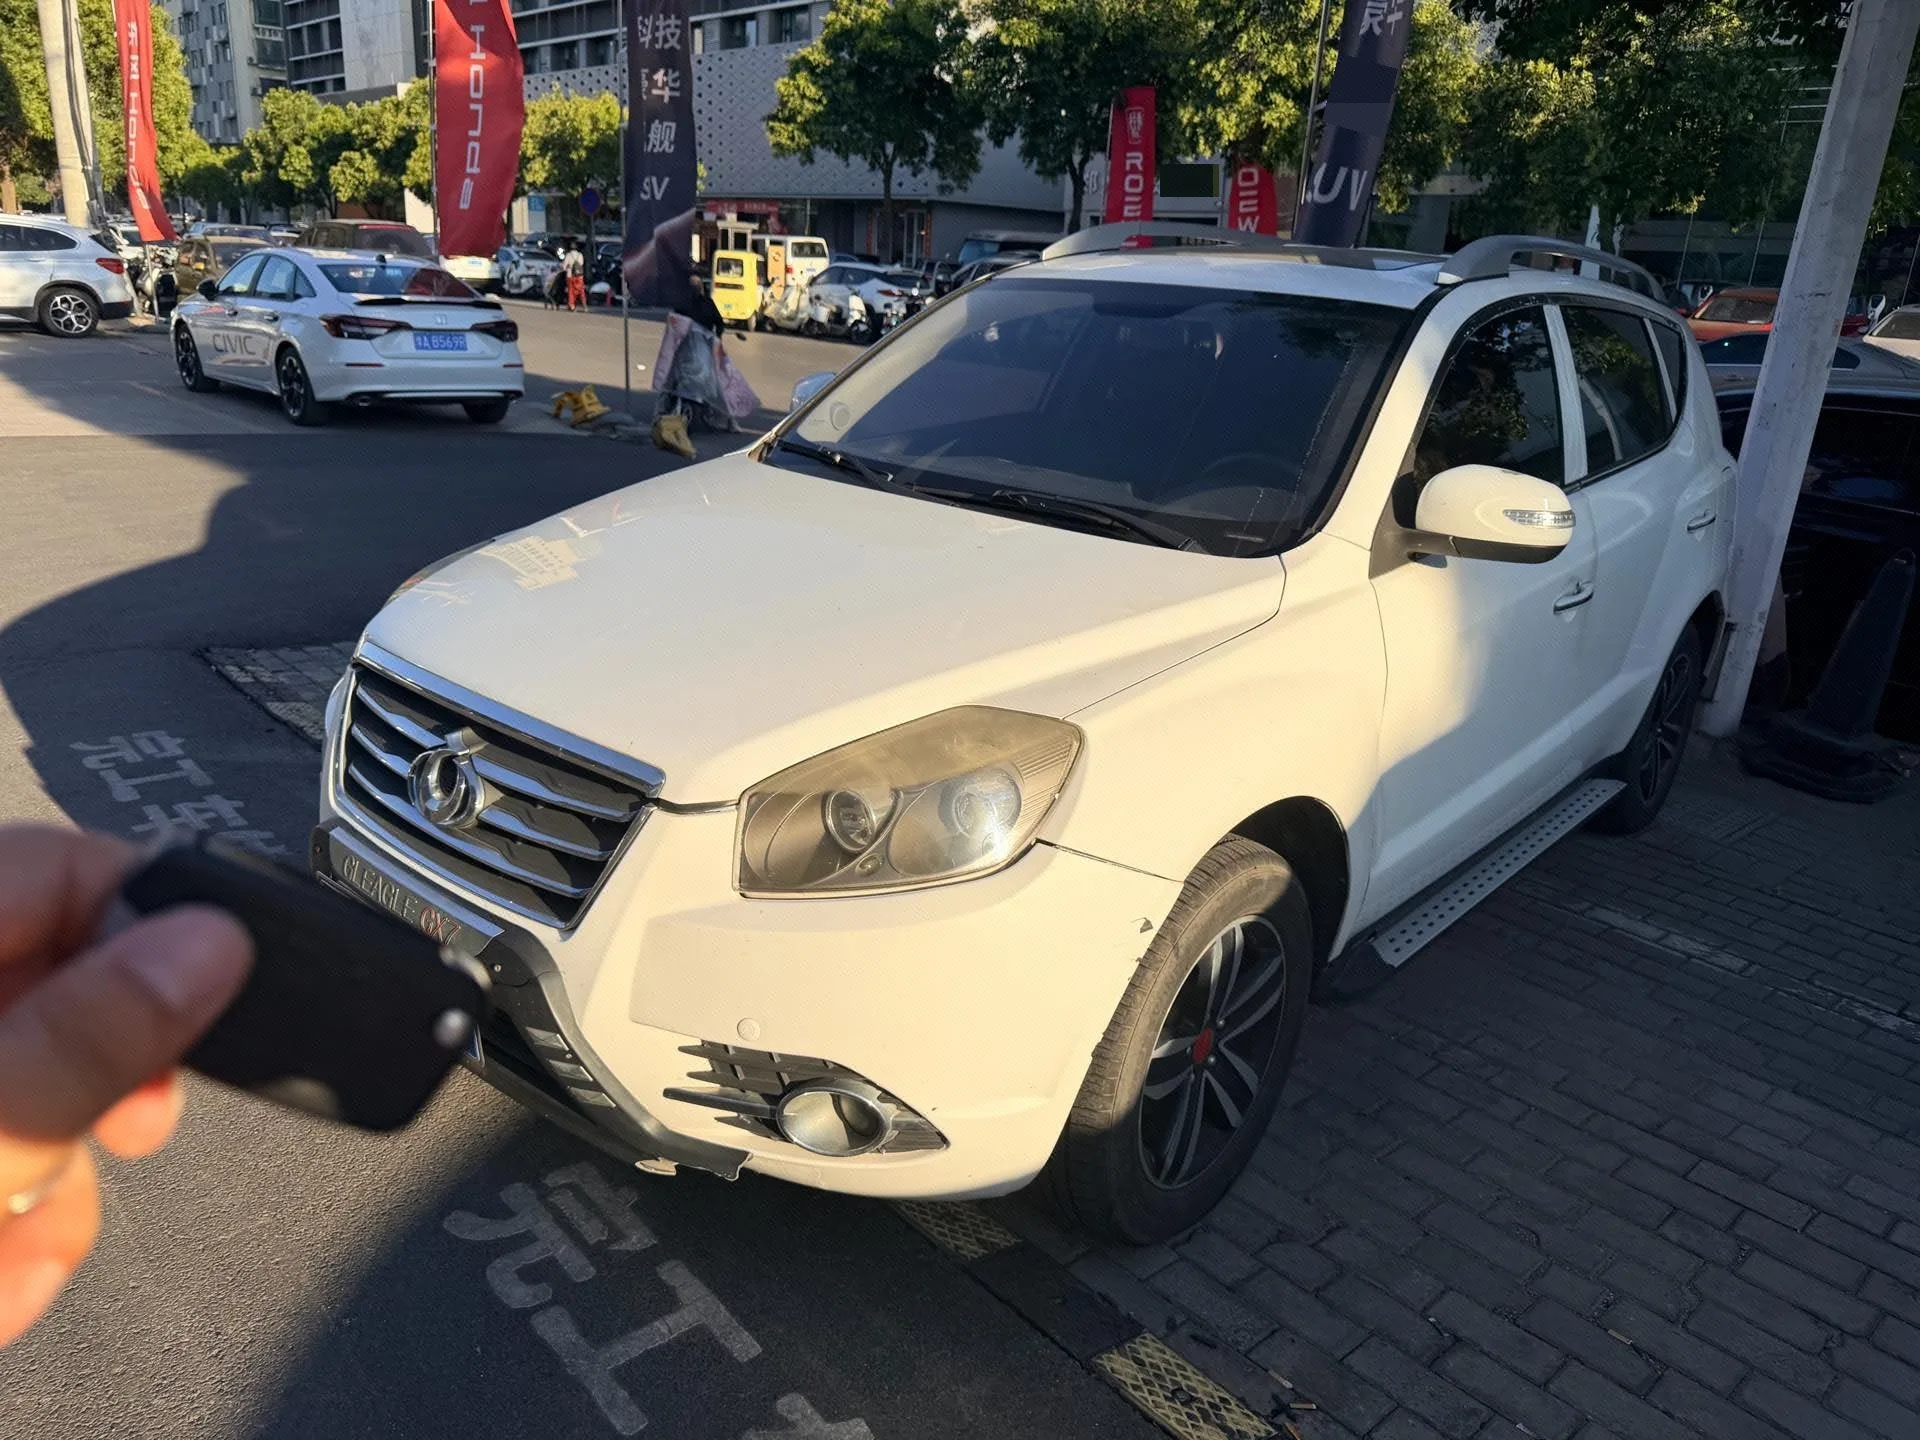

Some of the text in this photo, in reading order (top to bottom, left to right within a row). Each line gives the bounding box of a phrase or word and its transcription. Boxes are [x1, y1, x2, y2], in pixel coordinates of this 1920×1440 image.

[128, 92, 151, 209] Honda
[459, 24, 487, 209] Honda
[643, 119, 677, 154] 舰
[1306, 162, 1368, 211] UV
[212, 332, 256, 356] CIVIC
[343, 855, 462, 946] GLEAGLE GX7
